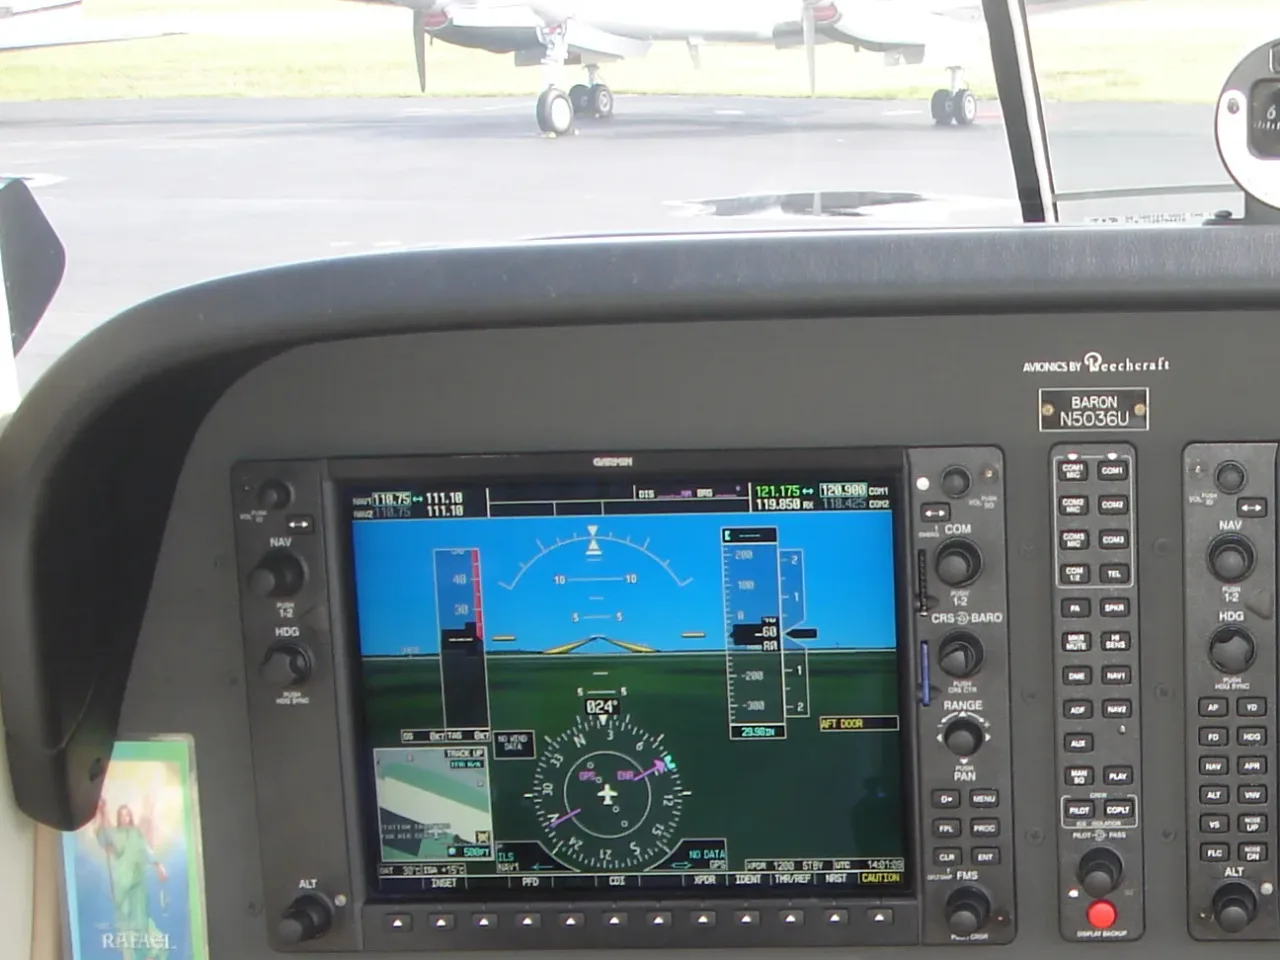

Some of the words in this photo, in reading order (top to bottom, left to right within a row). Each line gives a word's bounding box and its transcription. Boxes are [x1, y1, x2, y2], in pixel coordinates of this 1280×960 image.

[1267, 108, 1276, 119] 6
[1023, 360, 1067, 372] AVIONICS
[1068, 360, 1081, 372] BY
[1085, 352, 1170, 372] Beechcraft
[1072, 396, 1117, 408] BARON
[1060, 412, 1129, 426] N5036U
[593, 457, 632, 467] GARMIN
[756, 486, 799, 497] 121.175
[373, 493, 410, 505] 110.75
[756, 498, 800, 510] 119.850
[945, 524, 971, 534] COM
[1219, 520, 1242, 531] NAV
[270, 537, 292, 547] NAV
[932, 613, 954, 623] CRS
[971, 613, 1002, 623] BARO
[1219, 611, 1244, 621] HDG
[275, 627, 299, 636] HDG
[944, 700, 983, 710] RANGE
[821, 719, 837, 729] AFT
[840, 718, 863, 728] DOOR
[954, 771, 976, 781] PAN
[704, 849, 725, 859] DATA
[956, 871, 978, 881] FMS
[1225, 867, 1244, 876] ALT
[522, 878, 539, 886] PFD
[609, 876, 625, 885] CDI
[693, 874, 716, 885] XPDR
[735, 874, 761, 884] IDENT
[825, 873, 847, 883] NRST
[862, 873, 900, 883] CAUTION
[299, 879, 318, 888] ALT
